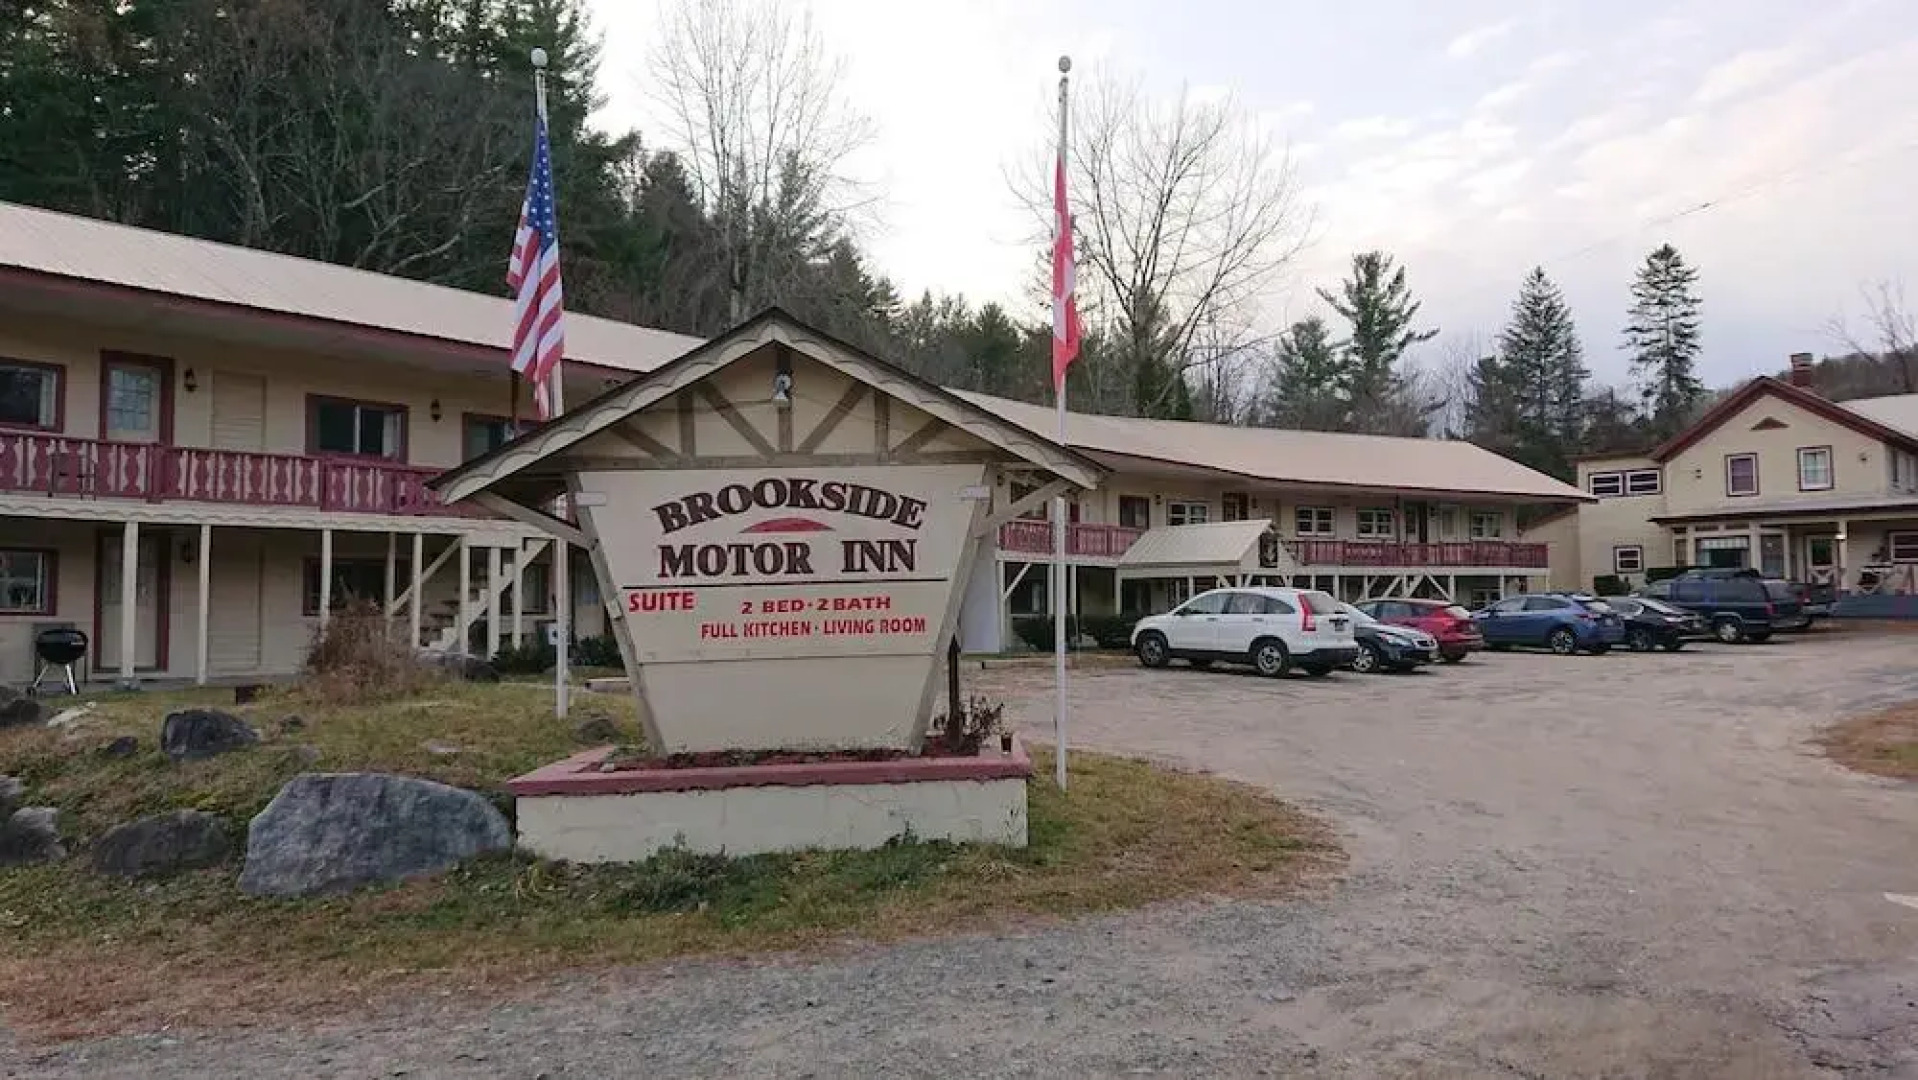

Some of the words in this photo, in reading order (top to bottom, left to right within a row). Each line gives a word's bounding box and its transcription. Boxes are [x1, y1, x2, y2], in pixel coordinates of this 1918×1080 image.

[651, 477, 927, 533] BROOKSIDE
[658, 542, 814, 578] MOTOR
[841, 538, 917, 573] INN
[628, 591, 695, 612] SUITE
[740, 603, 752, 614] 2
[762, 600, 804, 613] BED
[701, 623, 738, 640] FULL
[743, 620, 811, 638] KITCHEN
[823, 618, 875, 635] LIVING
[879, 616, 926, 634] ROOM
